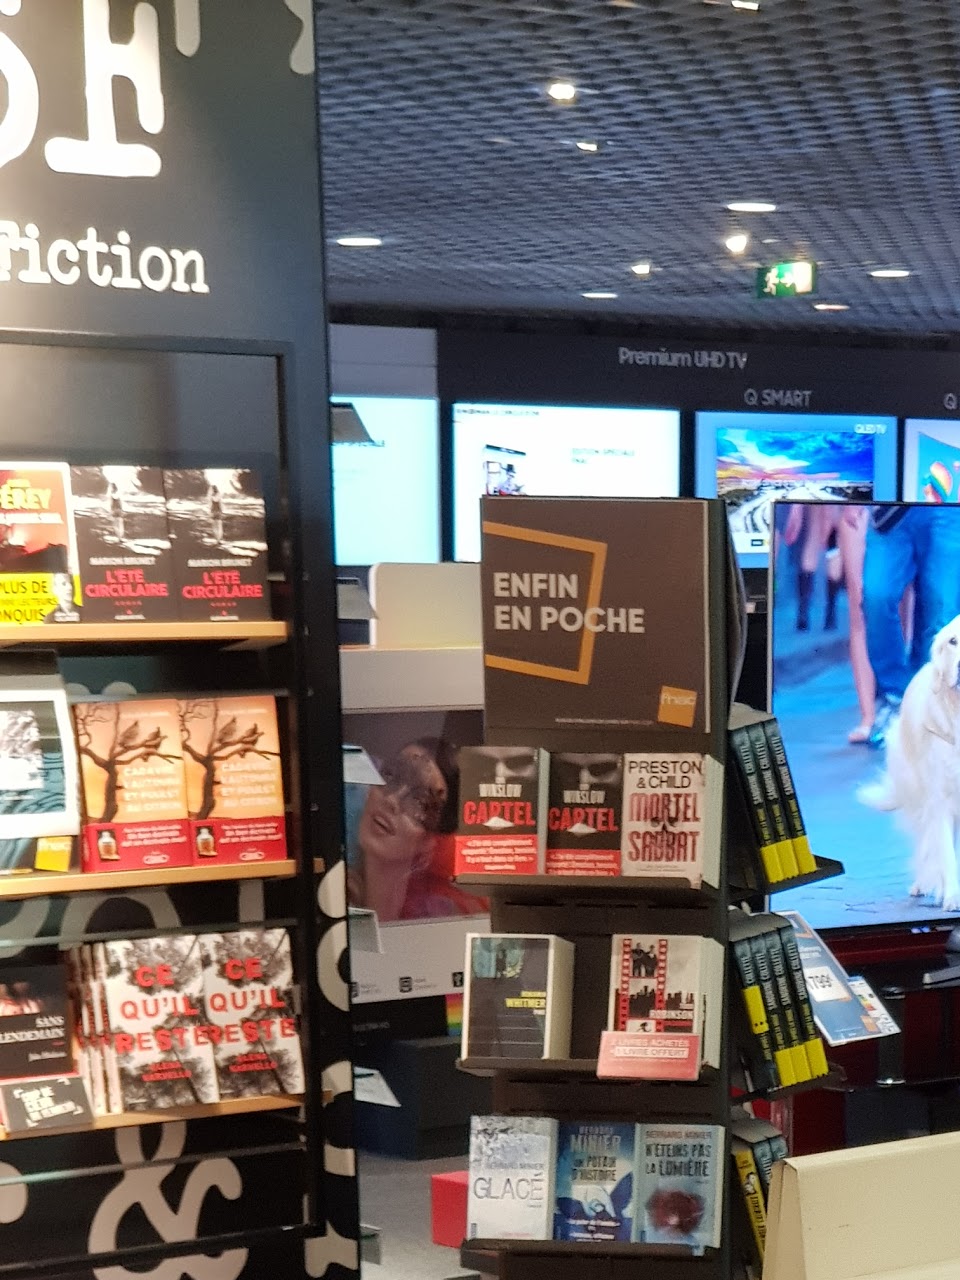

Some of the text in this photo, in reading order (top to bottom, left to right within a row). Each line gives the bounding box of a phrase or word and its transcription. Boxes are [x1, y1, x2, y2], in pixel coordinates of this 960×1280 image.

[618, 347, 749, 370] Premium UHD TV
[744, 389, 812, 408] Q SMART
[943, 392, 957, 410] Q
[31, 581, 48, 594] DE
[85, 584, 169, 598] CIRCULAIRE
[182, 585, 263, 599] CIRCULAIRE
[493, 572, 579, 598] ENFIN
[494, 606, 645, 634] EN POCHE
[628, 761, 702, 774] PRESTON
[479, 783, 522, 798] WINSLOW
[637, 776, 691, 789] & CHILD
[463, 801, 536, 827] CARTEL
[629, 792, 702, 823] MORTEL
[548, 808, 619, 832] CARTEL
[628, 831, 698, 863] SABBAT
[135, 965, 174, 988] CE
[225, 958, 263, 980] CE
[120, 996, 199, 1020] QU'IL
[209, 988, 285, 1012] QU'IL
[28, 1016, 64, 1028] SANS
[115, 1025, 210, 1054] RESTE
[692, 1143, 712, 1158] PAS
[659, 1159, 710, 1176] LUMIÈRE
[473, 1174, 545, 1201] GLACÉ
